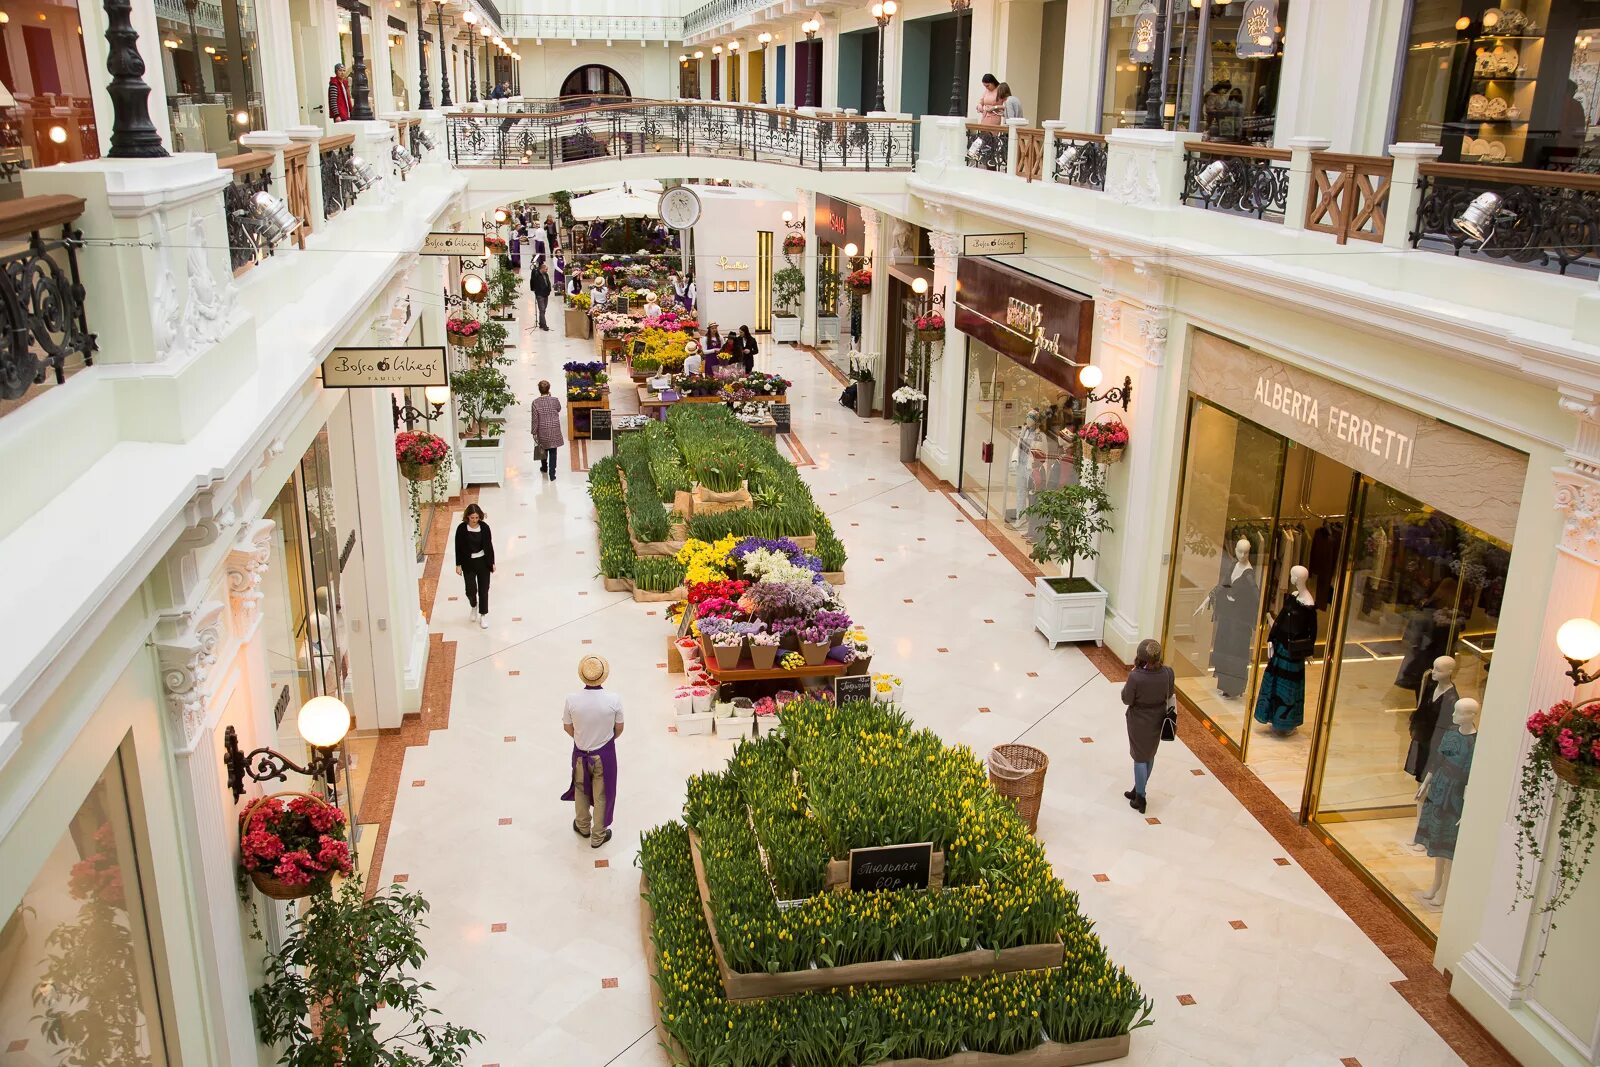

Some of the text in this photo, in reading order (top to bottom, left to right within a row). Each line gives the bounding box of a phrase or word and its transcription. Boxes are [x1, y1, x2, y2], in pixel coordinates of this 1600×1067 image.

[334, 355, 439, 378] Bosco Ciliegi
[1254, 376, 1414, 469] ALBERTA FERRETTI
